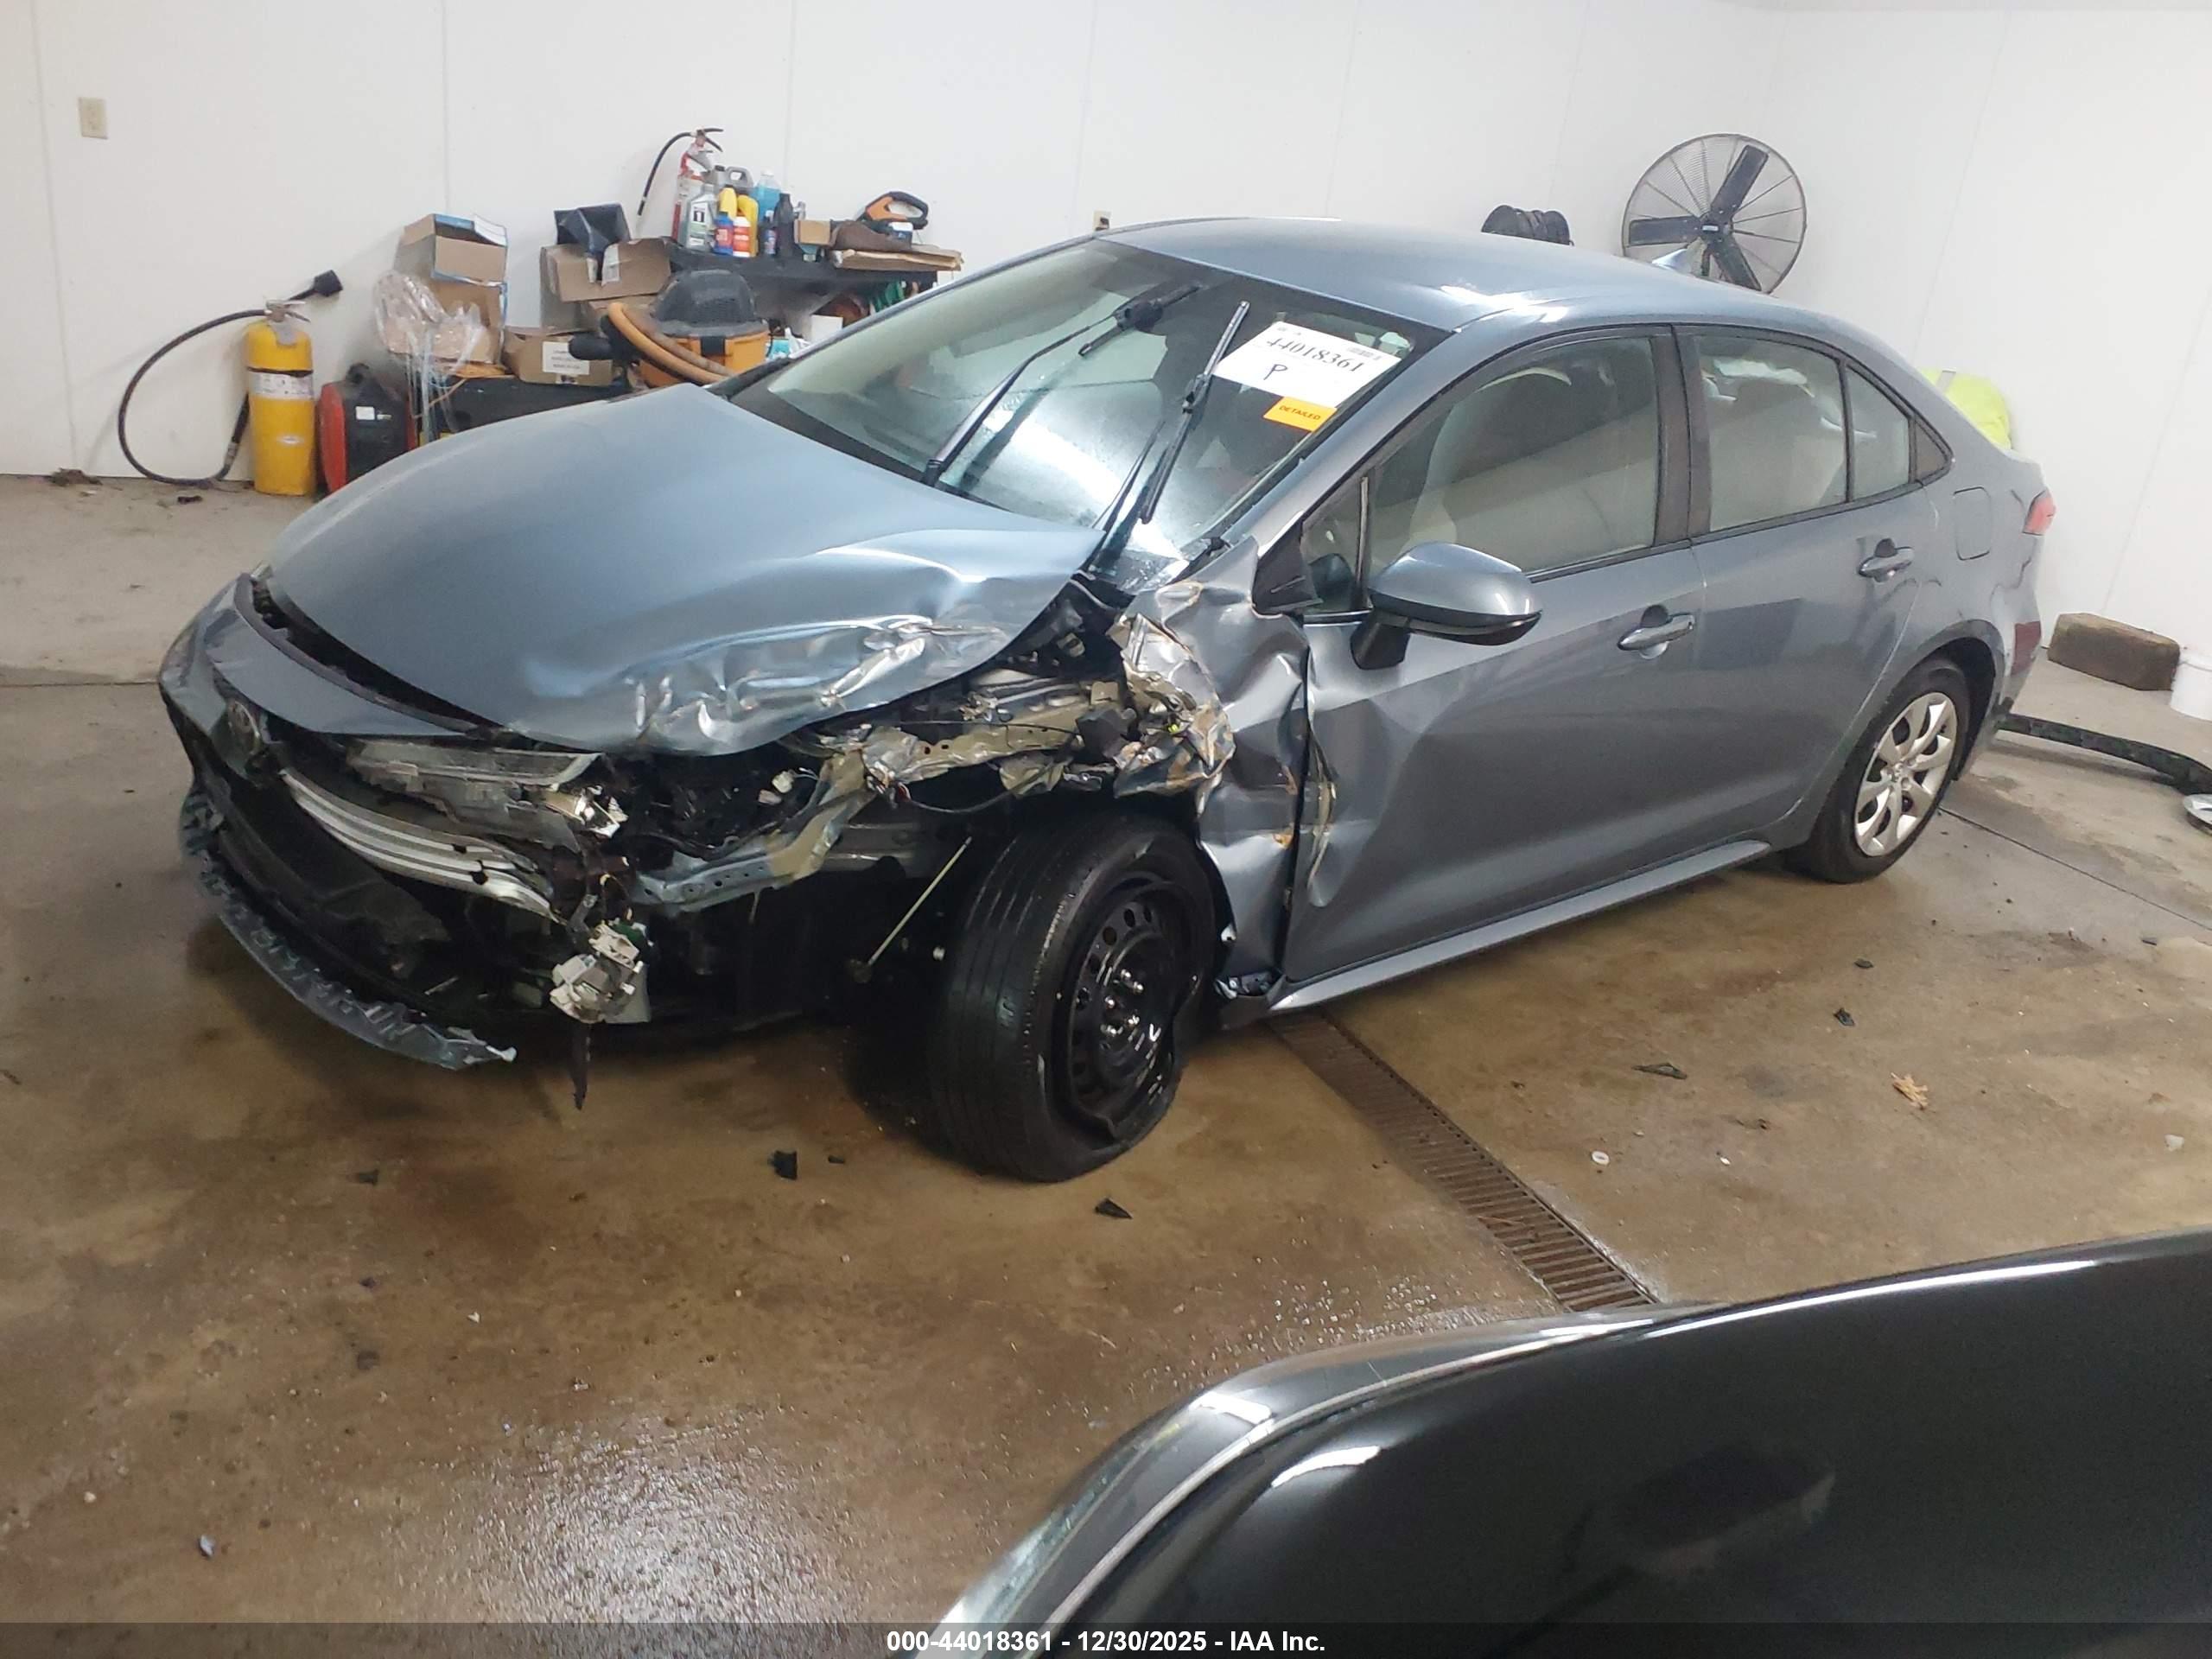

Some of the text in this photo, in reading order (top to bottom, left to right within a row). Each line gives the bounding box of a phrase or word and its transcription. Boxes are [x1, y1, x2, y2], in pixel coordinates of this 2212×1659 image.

[1267, 337, 1365, 372] 44018361
[1263, 364, 1288, 381] P
[1279, 405, 1321, 421] DETAILED
